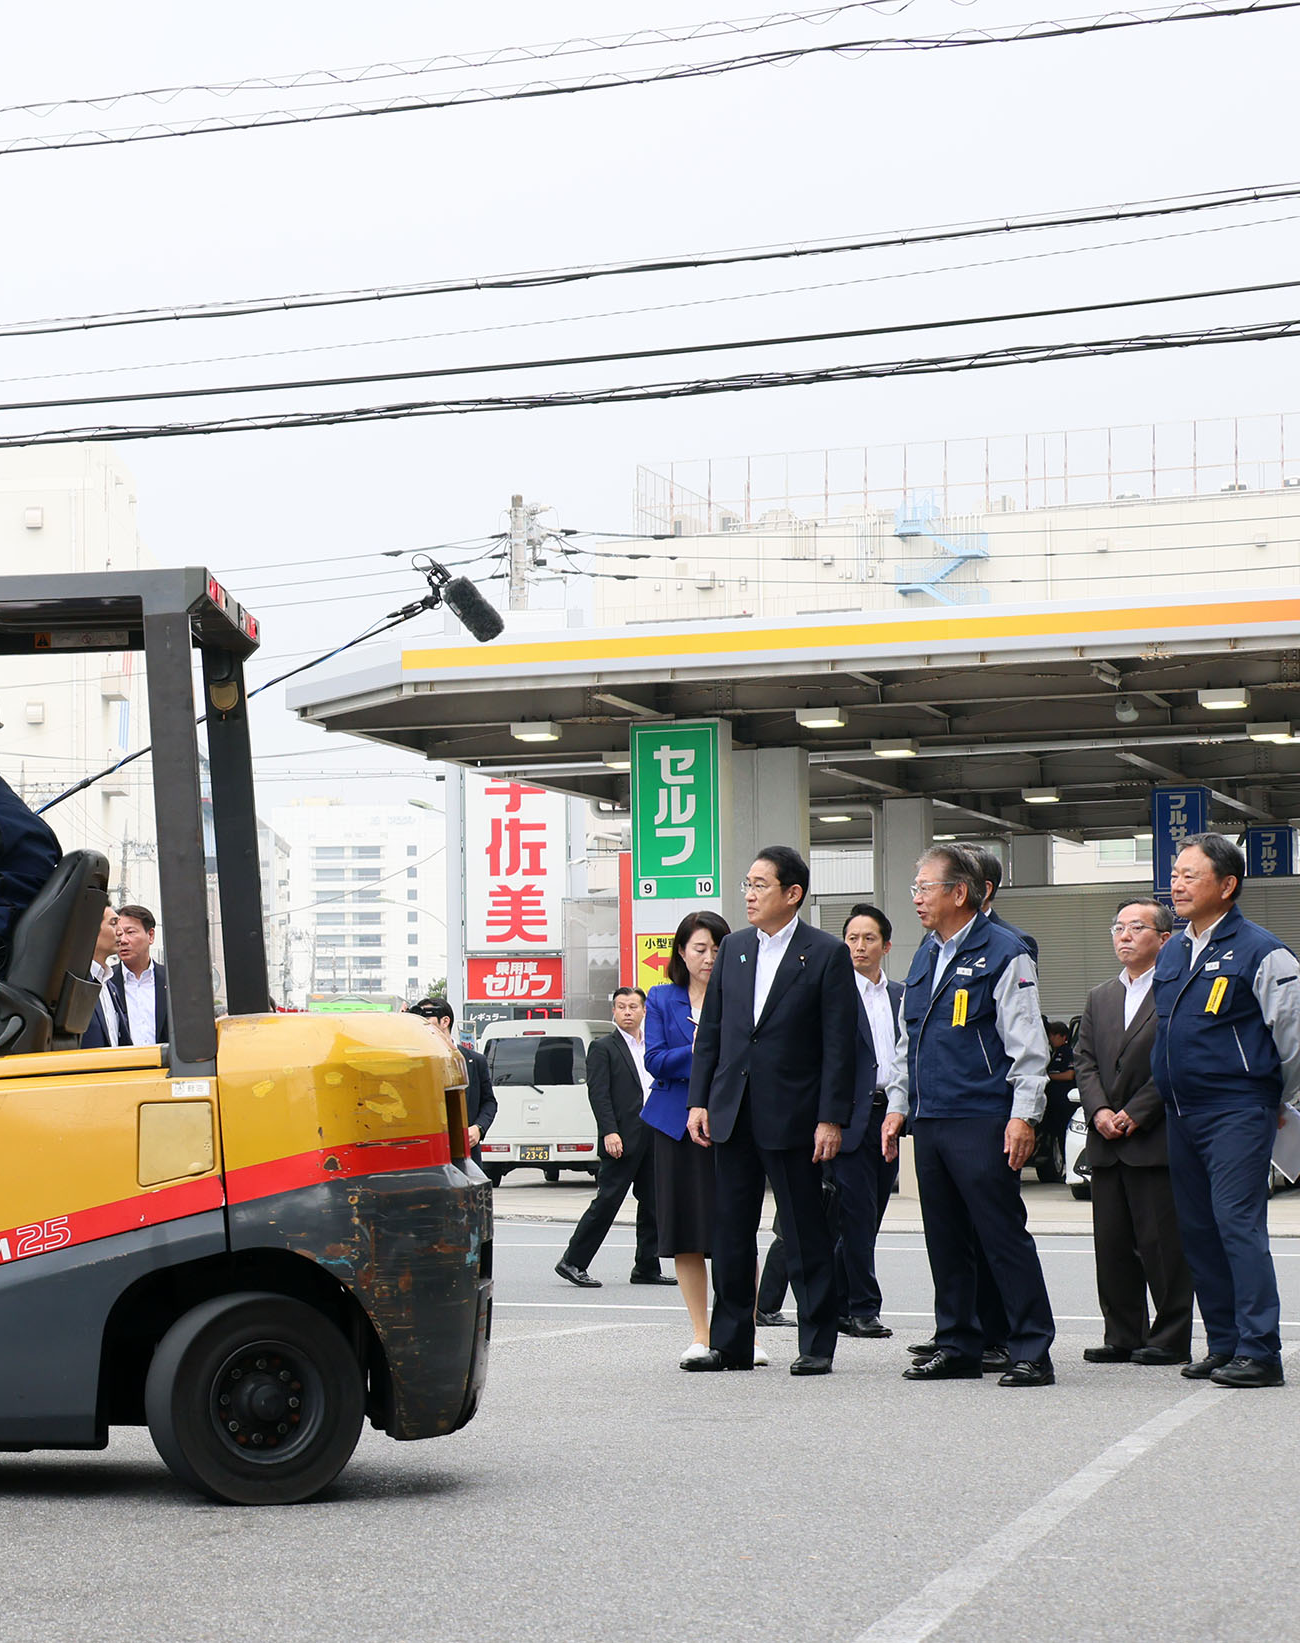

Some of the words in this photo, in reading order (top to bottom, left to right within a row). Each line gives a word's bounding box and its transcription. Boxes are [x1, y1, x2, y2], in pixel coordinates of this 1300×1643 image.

[653, 745, 697, 867] セルフ
[644, 884, 653, 894] 9
[698, 881, 712, 893] 10
[495, 961, 538, 975] 乗用車
[482, 974, 552, 997] セルフ
[470, 1013, 507, 1021] レギュラー
[16, 1216, 72, 1257] 25
